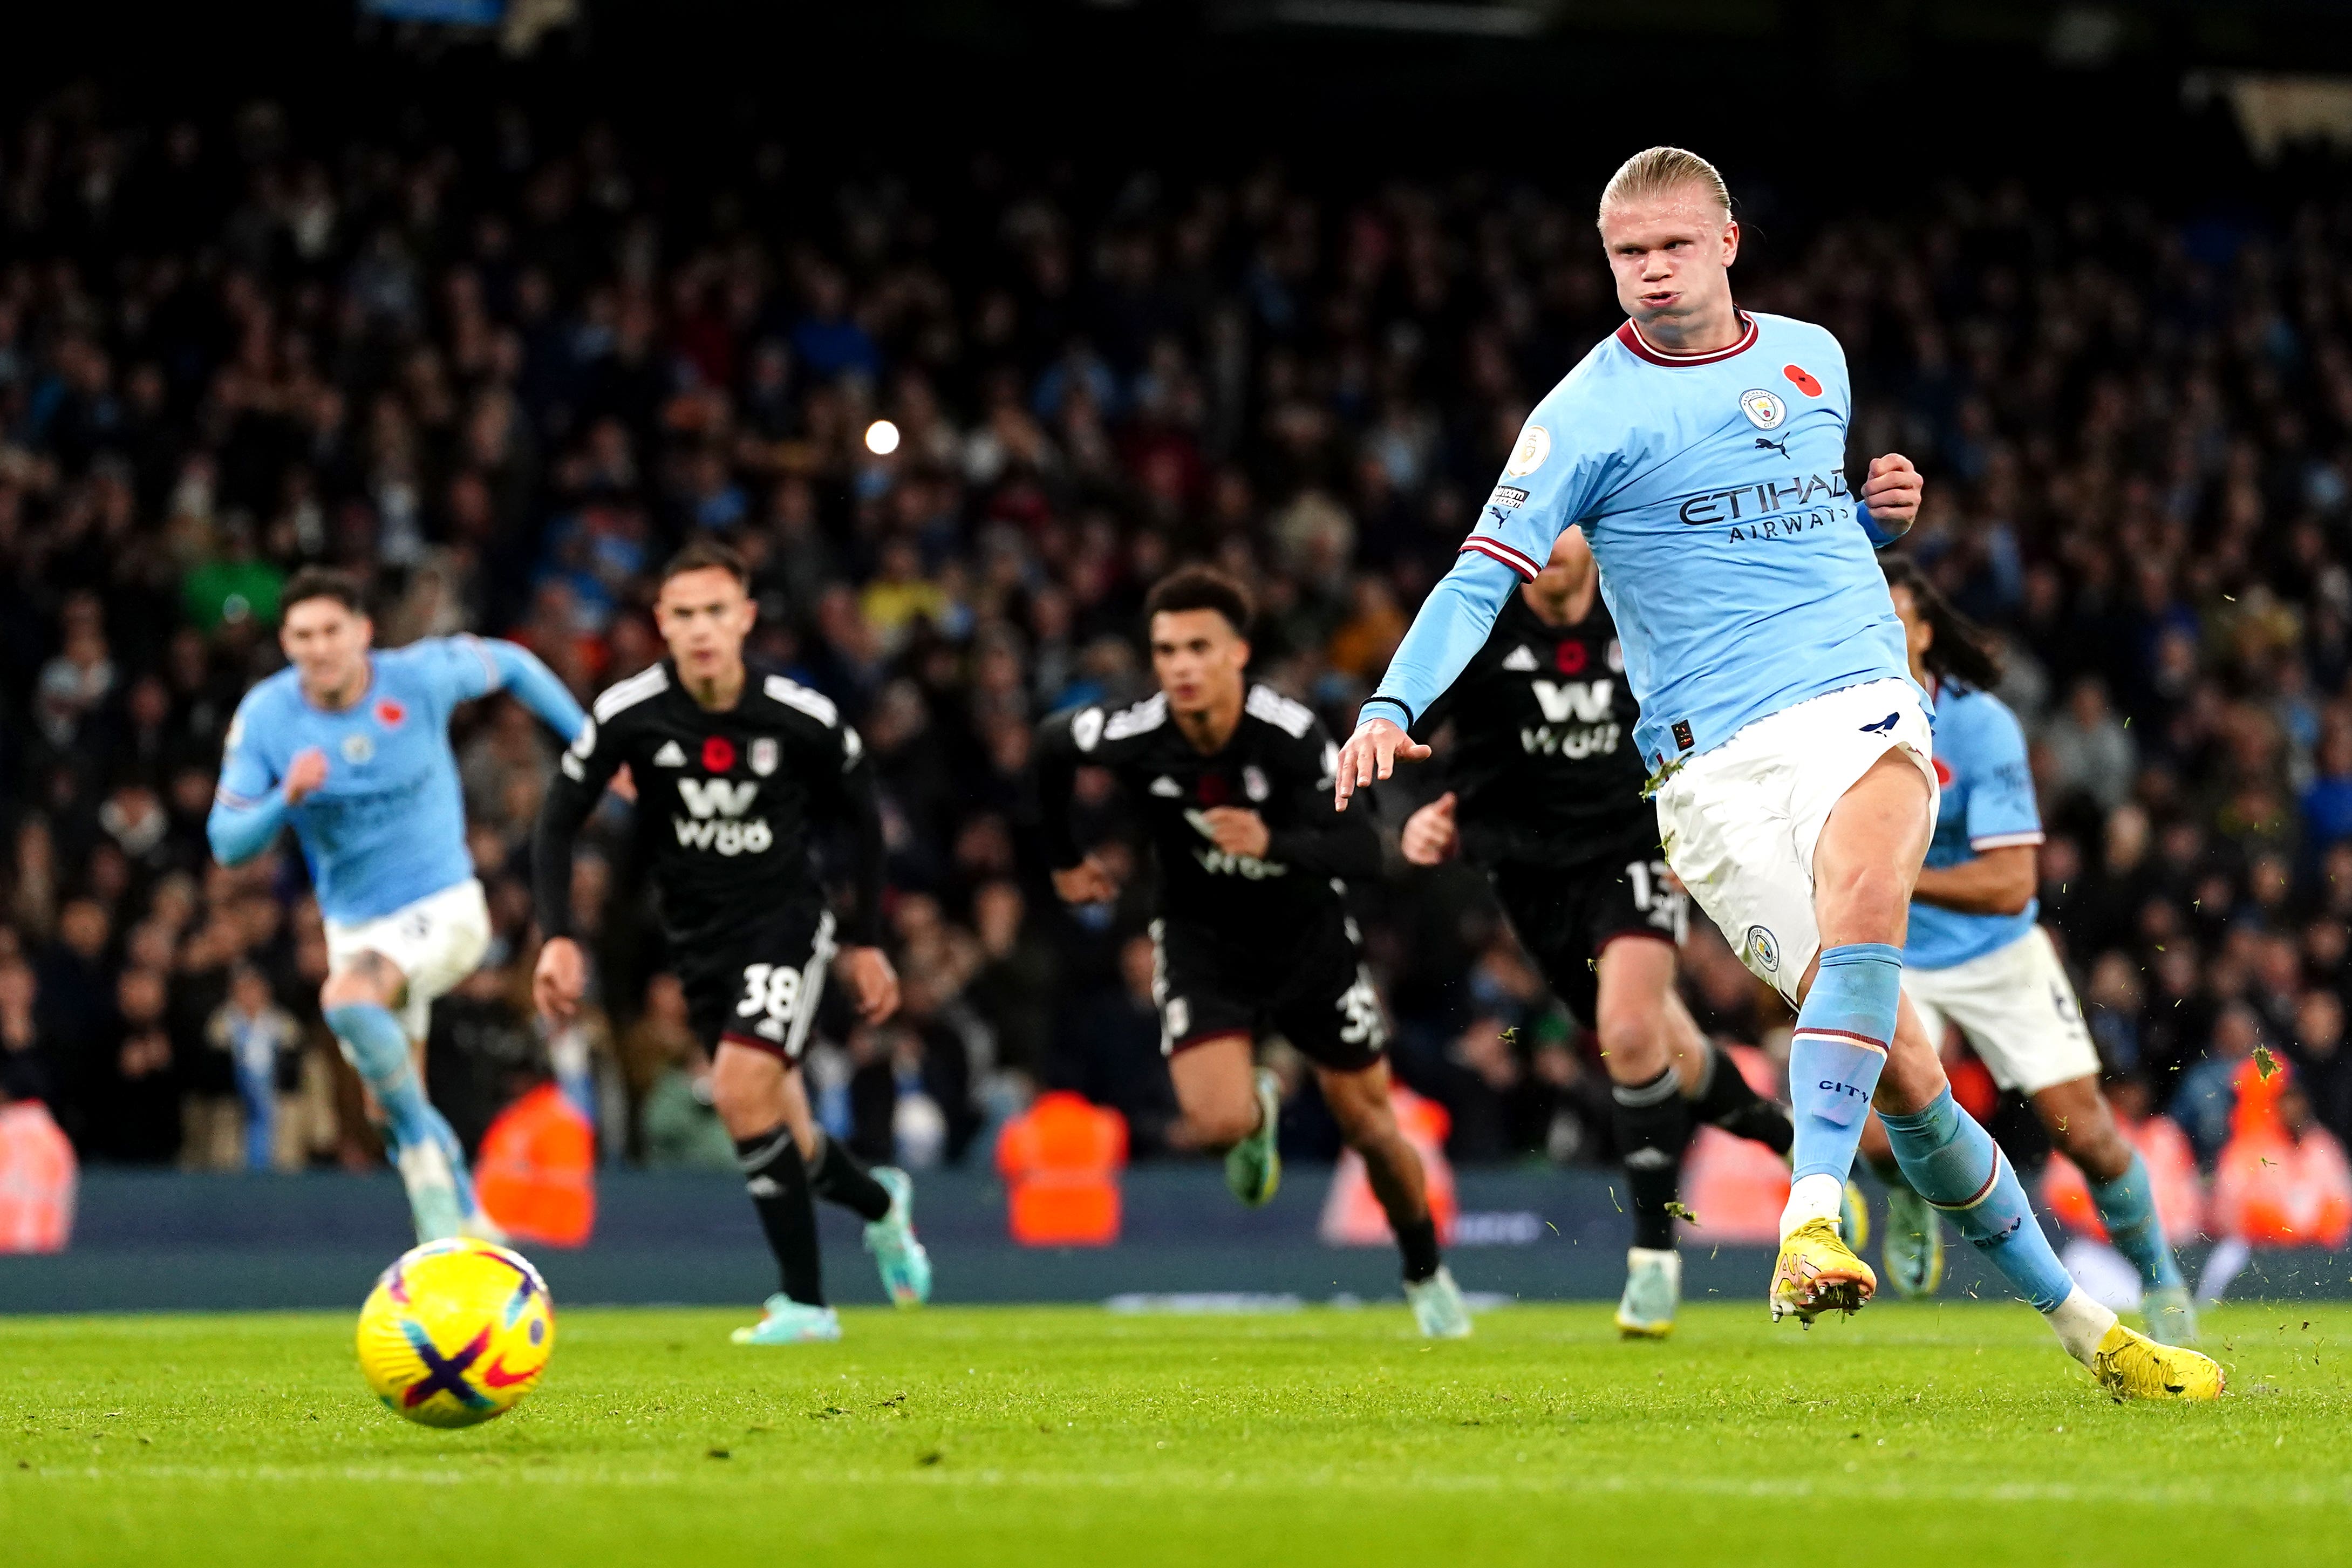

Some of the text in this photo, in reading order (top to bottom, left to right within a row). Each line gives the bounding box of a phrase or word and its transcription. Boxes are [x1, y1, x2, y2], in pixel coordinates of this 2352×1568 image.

[1502, 488, 1525, 501] room
[736, 963, 802, 1023] 38
[1819, 1080, 1869, 1103] CITY
